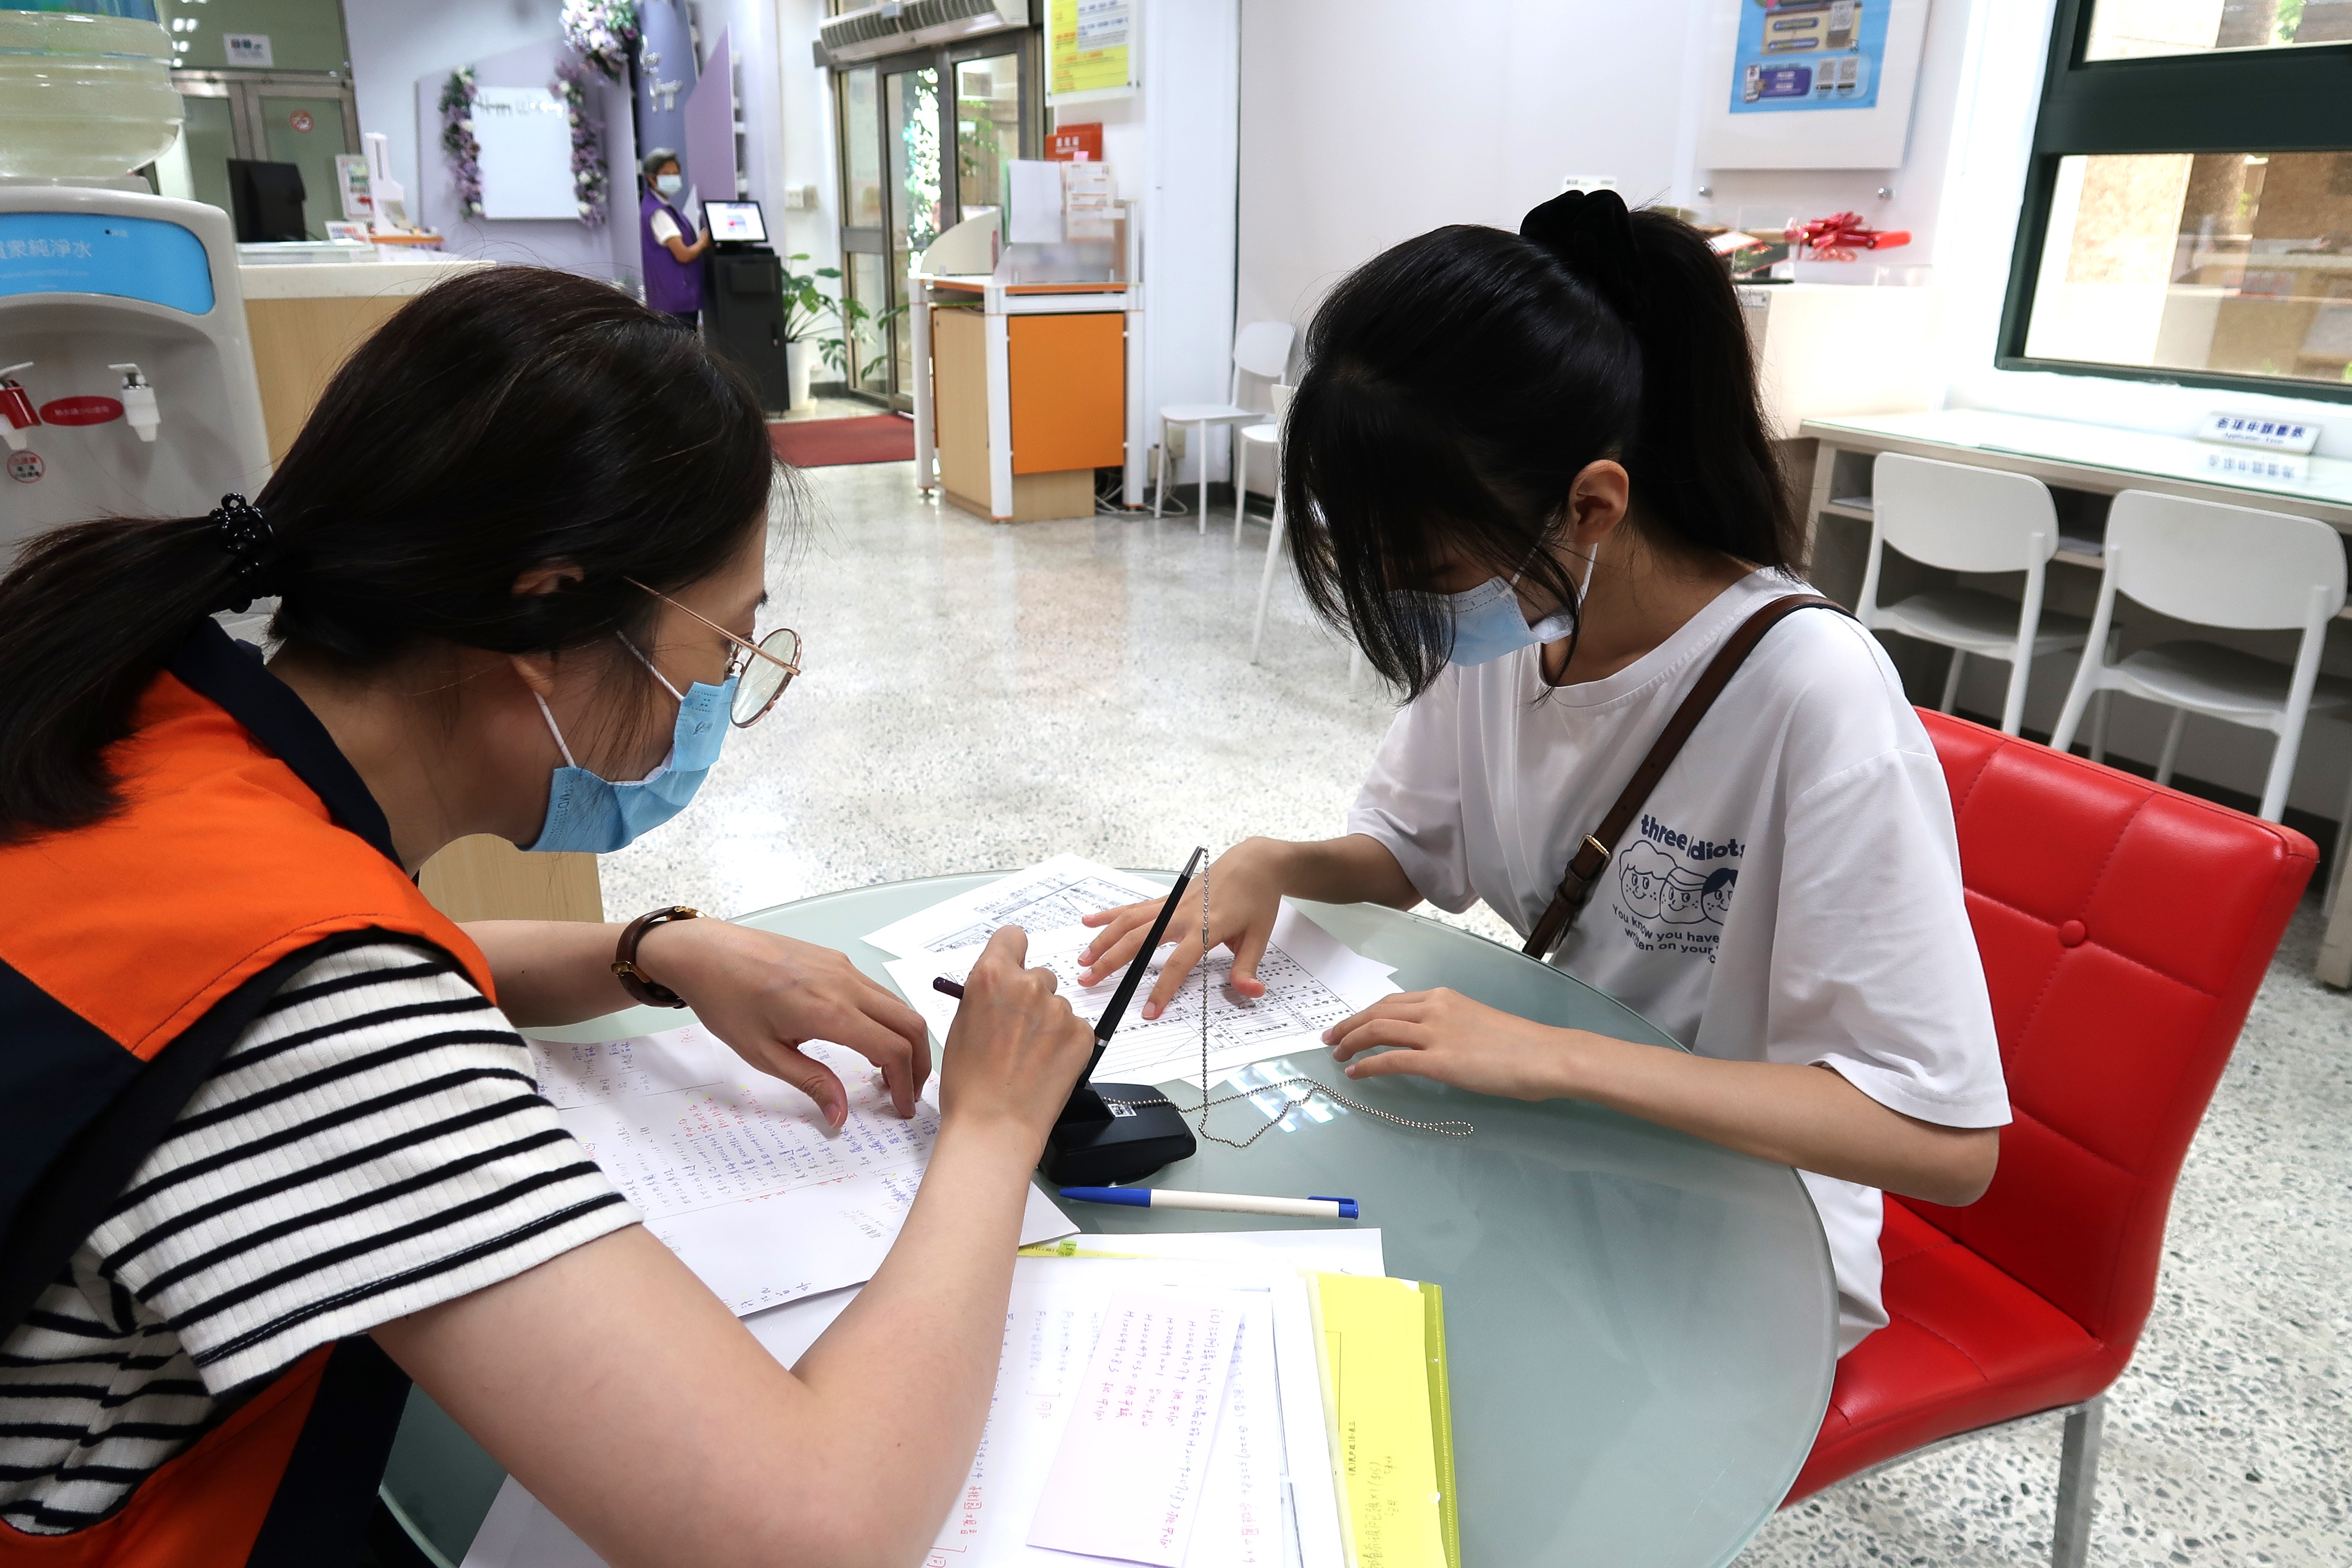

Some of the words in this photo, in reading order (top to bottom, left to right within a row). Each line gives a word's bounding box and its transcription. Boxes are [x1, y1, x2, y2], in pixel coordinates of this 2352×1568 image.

[1641, 814, 1687, 851] three
[1612, 903, 1629, 923] You
[1632, 916, 1653, 939] know
[1657, 931, 1682, 942] you
[1687, 931, 1720, 943] have
[1658, 942, 1676, 950] on
[1680, 944, 1712, 955] your
